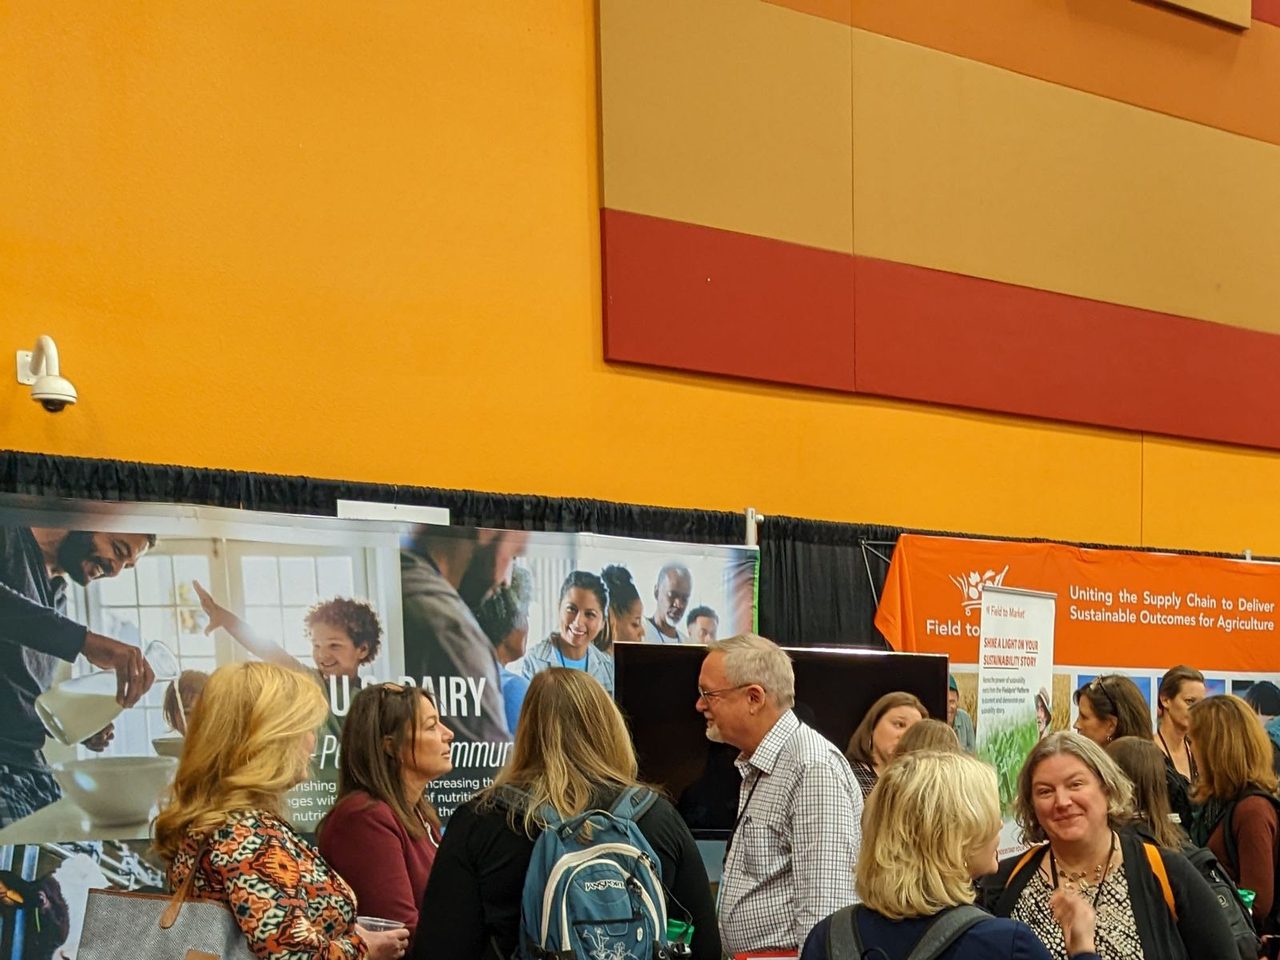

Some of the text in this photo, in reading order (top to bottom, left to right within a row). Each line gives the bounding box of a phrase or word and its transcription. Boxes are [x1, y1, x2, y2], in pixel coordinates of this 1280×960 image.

[1069, 585, 1275, 613] Uniting the Supply Chain to Deliver
[990, 605, 1002, 618] Field
[1070, 605, 1274, 632] Sustainable Outcomes for Agriculture
[926, 619, 980, 636] Field to
[1025, 640, 1039, 651] YOUR
[1020, 655, 1036, 668] STORY
